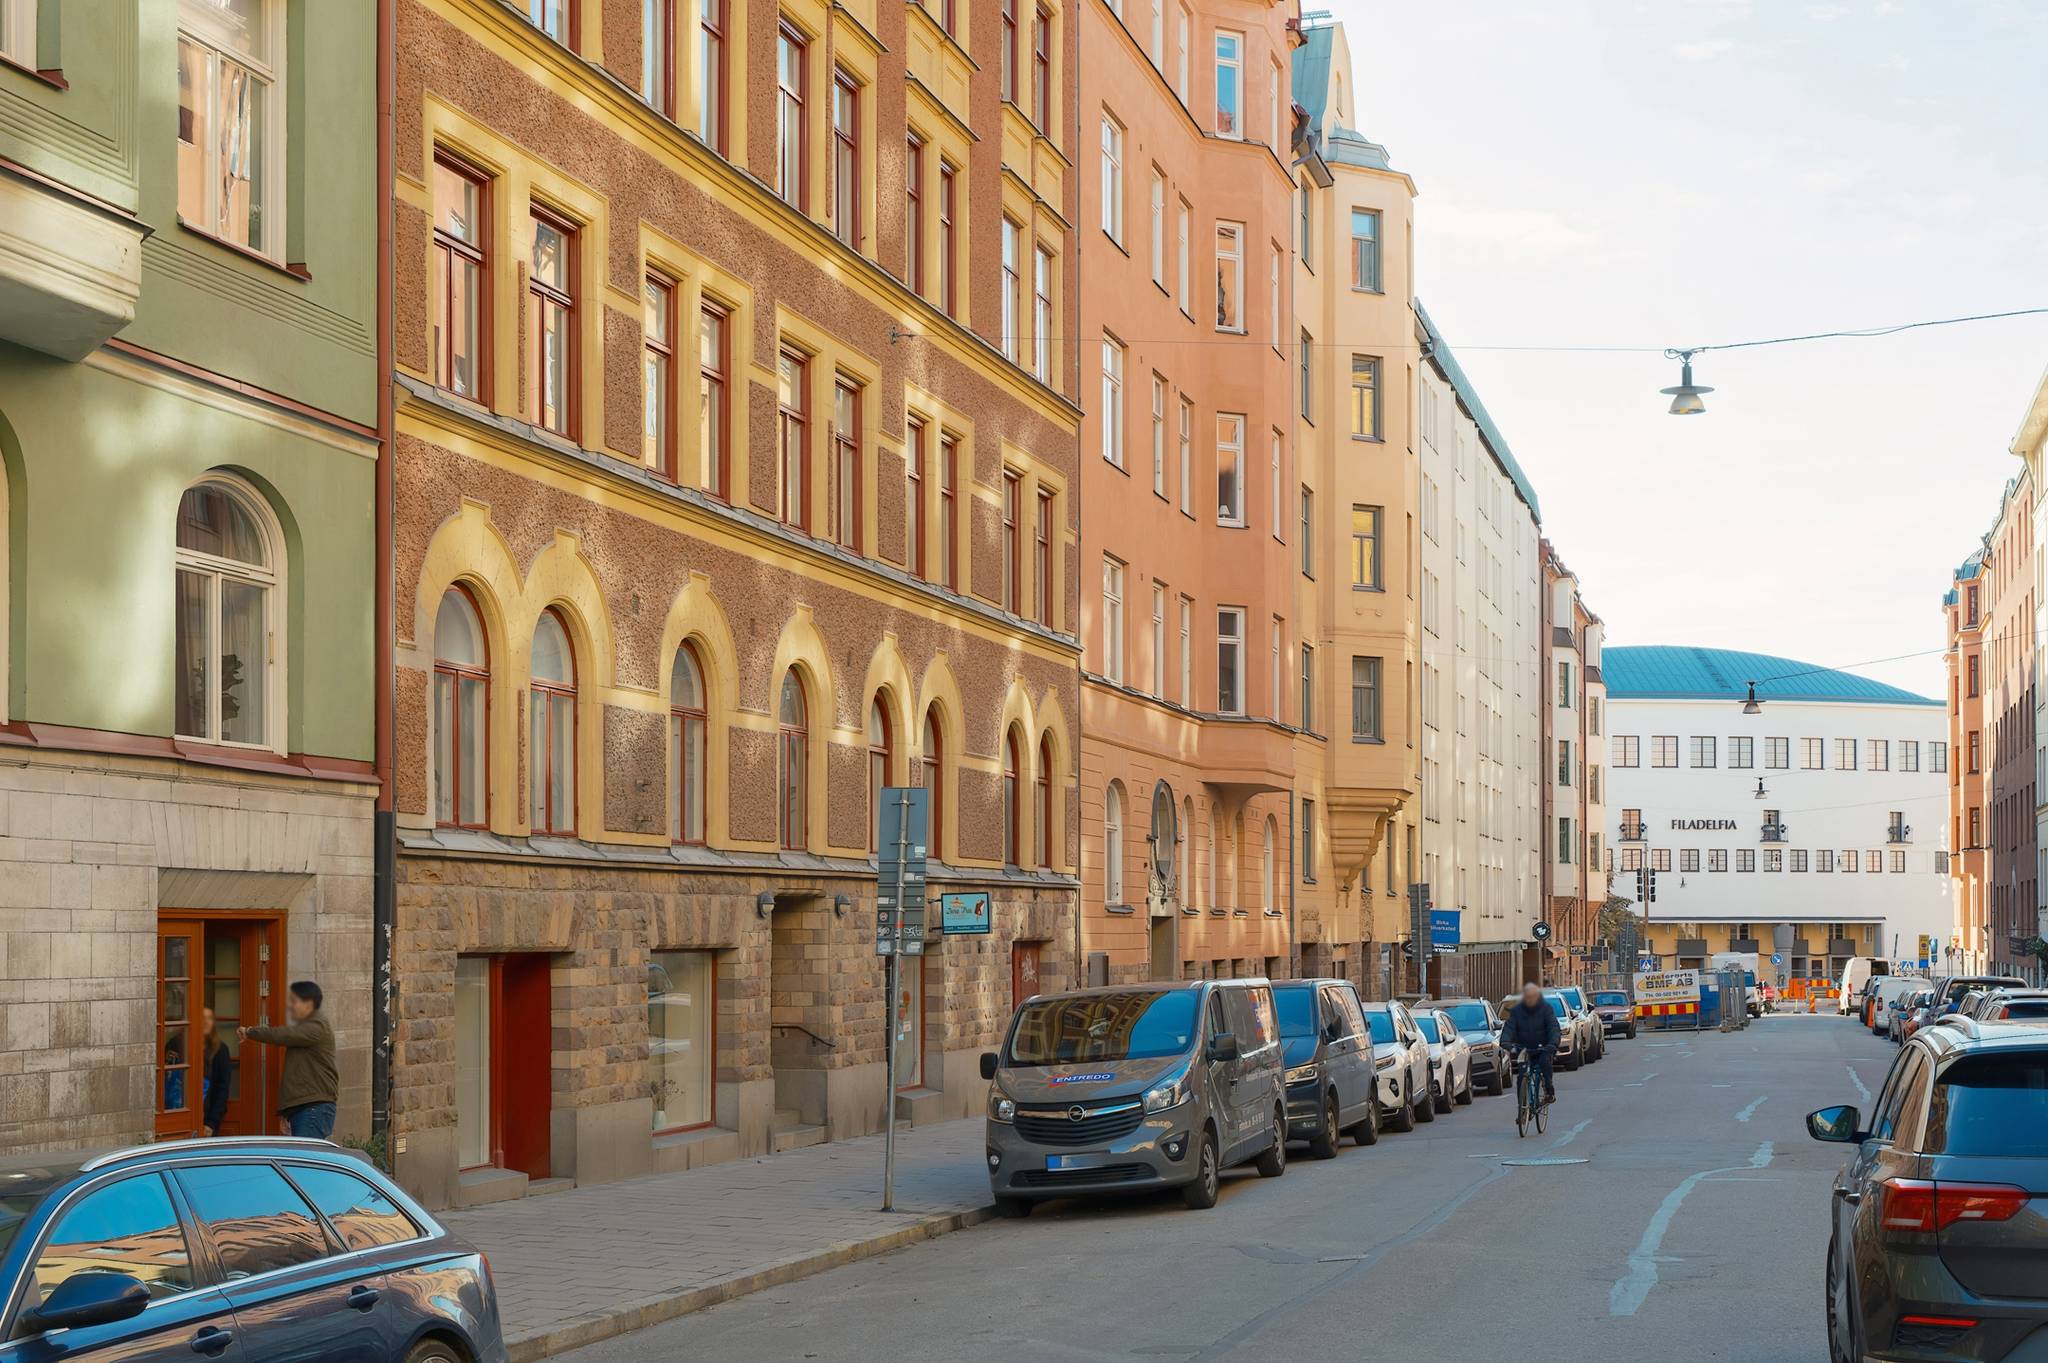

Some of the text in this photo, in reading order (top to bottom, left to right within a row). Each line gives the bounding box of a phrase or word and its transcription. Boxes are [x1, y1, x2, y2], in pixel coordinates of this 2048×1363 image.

[1671, 819, 1737, 830] FILADELFIA
[1646, 978, 1693, 989] BMF AB
[1056, 1074, 1111, 1082] ENTREDO
